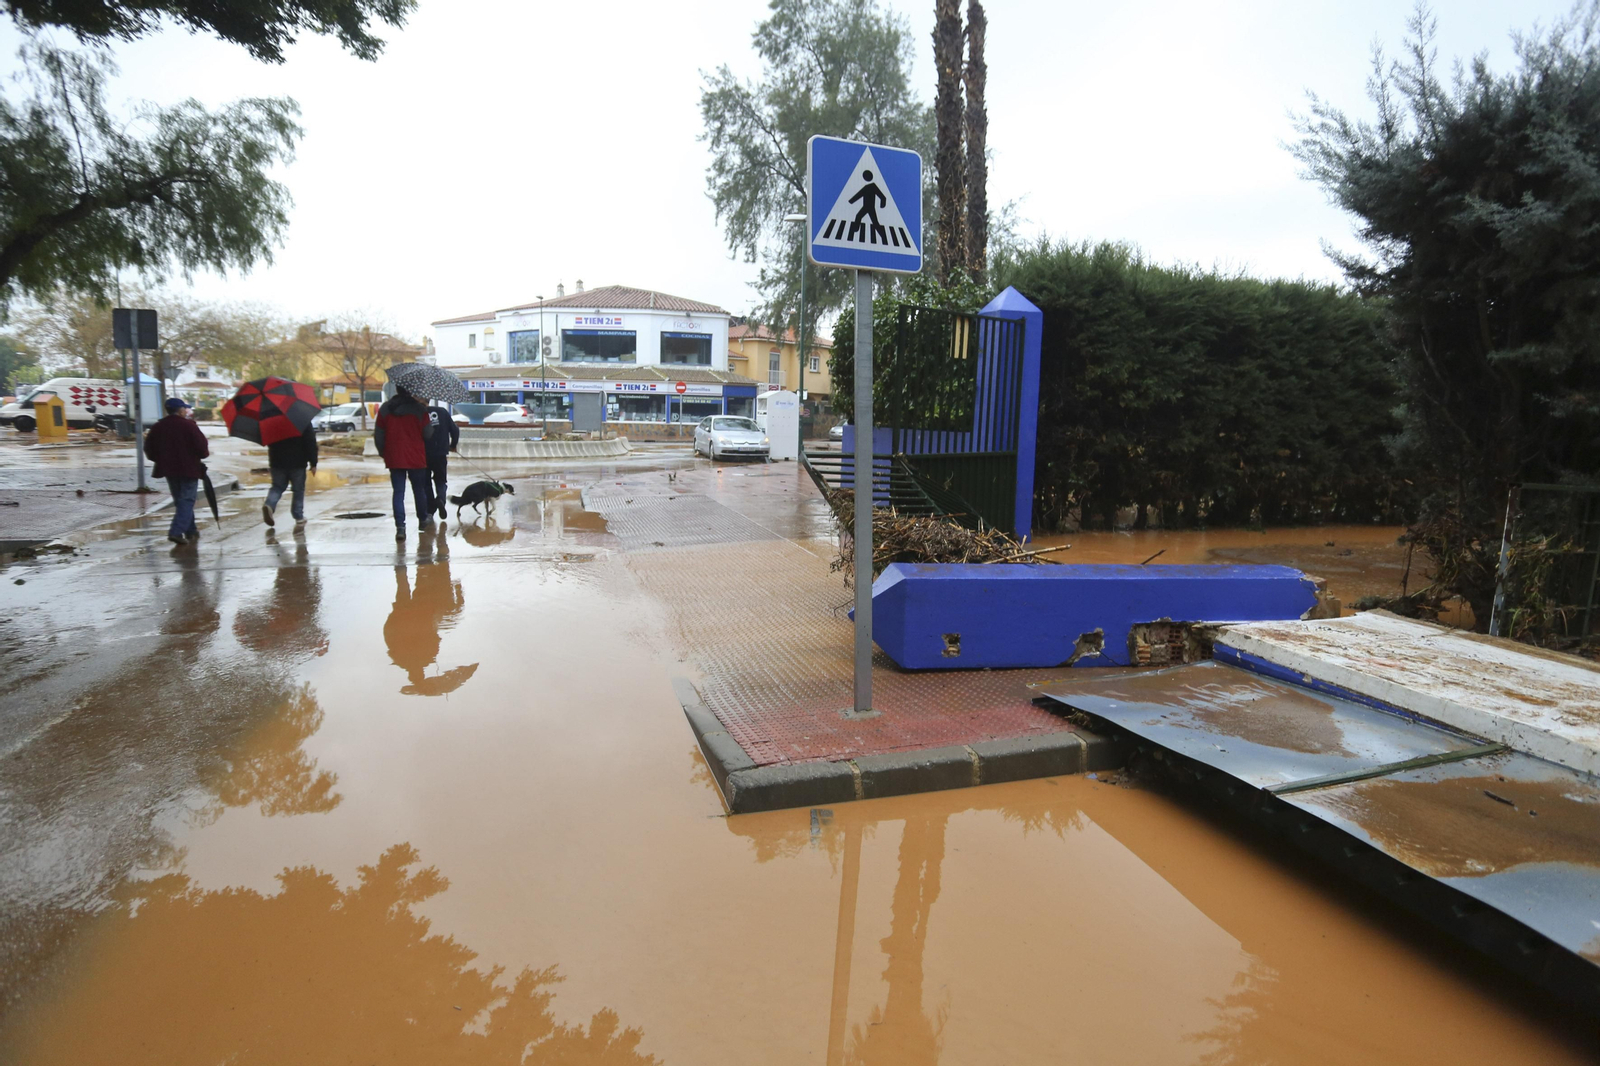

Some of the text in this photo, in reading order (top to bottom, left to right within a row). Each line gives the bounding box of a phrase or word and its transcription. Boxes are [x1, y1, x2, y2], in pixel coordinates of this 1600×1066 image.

[584, 317, 604, 325] TIEN
[531, 381, 550, 389] TIEN
[623, 383, 641, 391] TIEN
